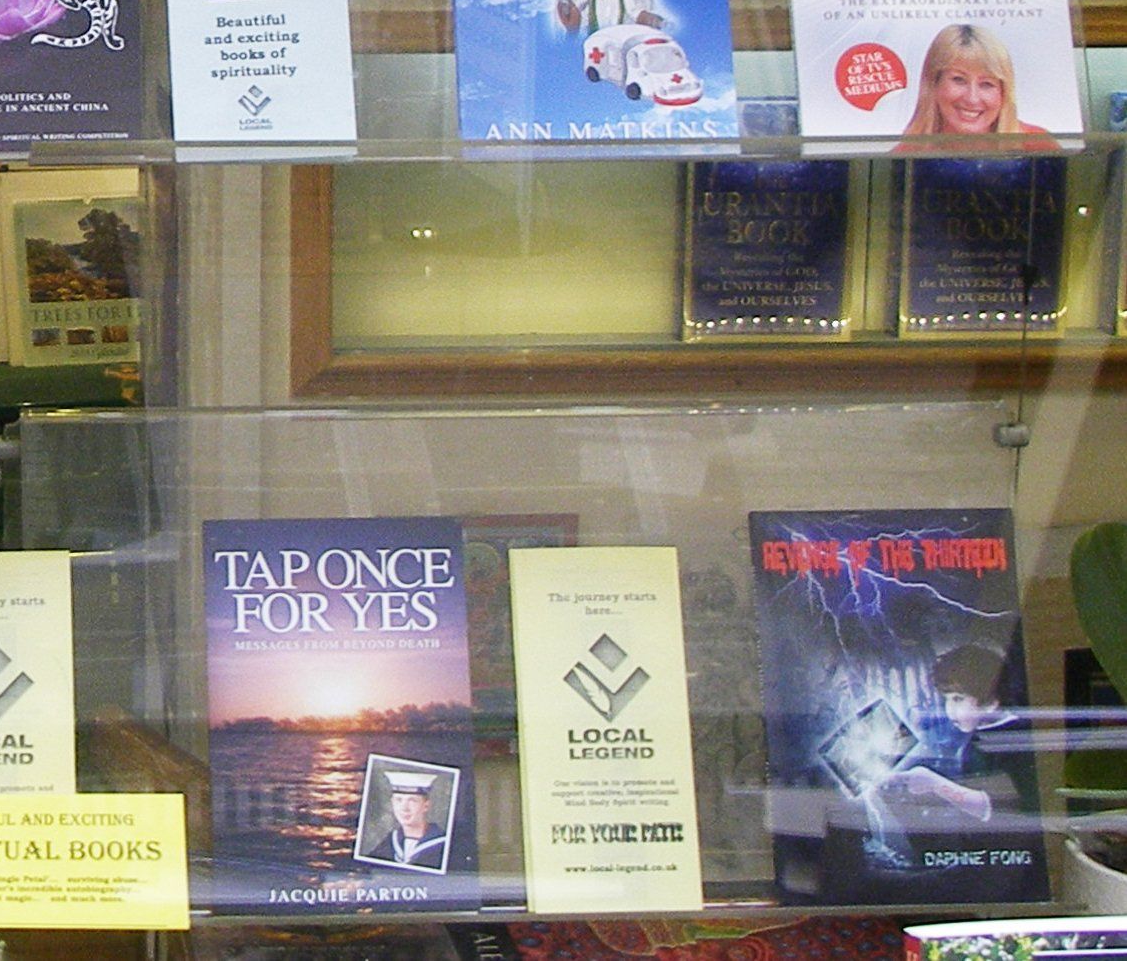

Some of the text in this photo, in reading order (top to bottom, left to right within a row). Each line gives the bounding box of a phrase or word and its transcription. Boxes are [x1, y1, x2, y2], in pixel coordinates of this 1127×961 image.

[217, 14, 286, 27] Beautiful
[824, 9, 1043, 20] OF AN UNLIKELY CLAIRVOYANT
[204, 32, 300, 44] and exciting
[221, 47, 286, 60] books of
[852, 52, 883, 63] STAR
[211, 65, 297, 79] spirituality
[848, 63, 864, 74] OF
[848, 72, 897, 85] RESCUE
[844, 81, 904, 97] MEDIUMS
[48, 92, 72, 101] AND
[21, 103, 69, 112] ANCIENT
[72, 102, 108, 111] CHINA
[485, 121, 718, 139] ANN MATKINS
[215, 548, 455, 590] TAP ONCE
[10, 597, 45, 606] starts
[574, 593, 657, 604] journey starts
[232, 591, 438, 634] FOR YES
[235, 639, 440, 651] MESSAGES FROM BEYOND DEATH
[568, 728, 653, 743] LOCAL
[569, 747, 654, 760] LEGEND
[20, 814, 54, 826] AND
[59, 814, 134, 826] EXCITING
[551, 824, 586, 843] FOR
[69, 840, 162, 861] BOOKS
[924, 850, 1031, 866] DAPHNE FONG
[269, 887, 428, 904] JACQUIE PARTON
